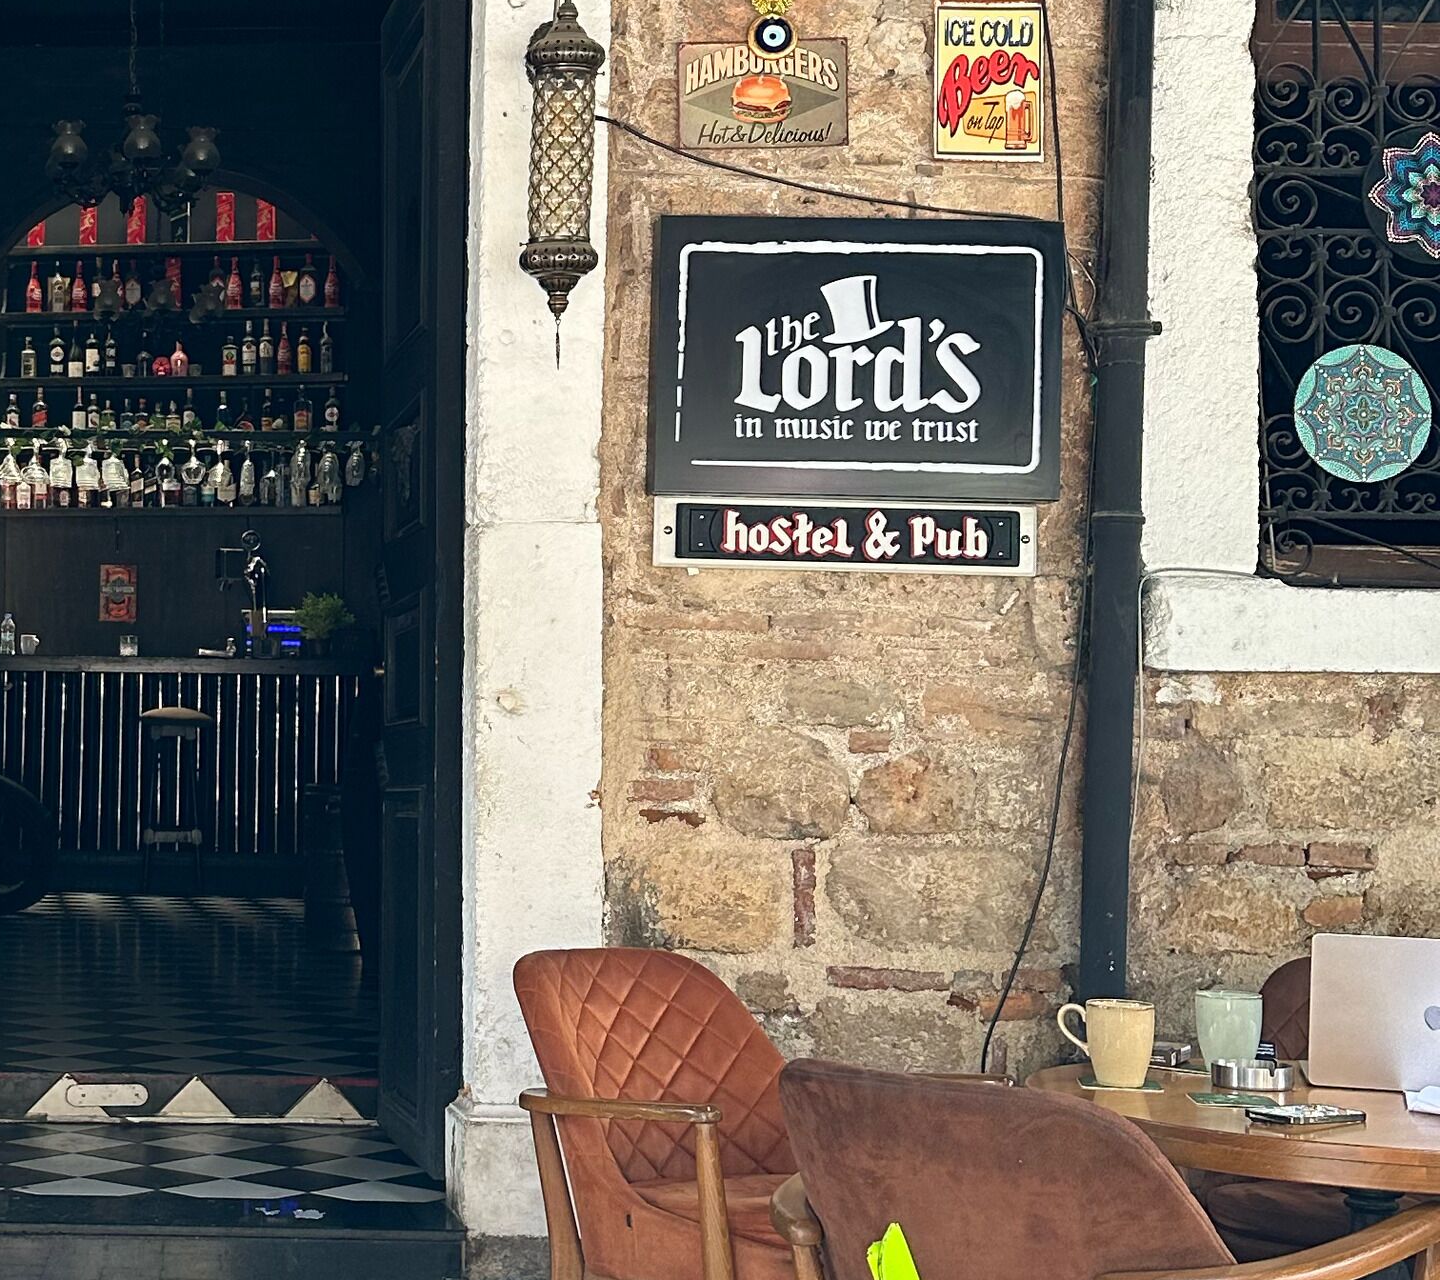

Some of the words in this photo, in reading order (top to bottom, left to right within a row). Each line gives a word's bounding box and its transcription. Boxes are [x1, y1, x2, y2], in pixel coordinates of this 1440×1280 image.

[944, 17, 975, 47] ICE
[979, 16, 1034, 48] COLD
[937, 49, 1040, 138] Beer
[966, 113, 984, 132] on
[980, 101, 1005, 145] Tap
[765, 311, 821, 356] the
[734, 413, 763, 439] in
[774, 414, 854, 441] music
[864, 418, 902, 441] we
[911, 416, 980, 443] trust
[722, 508, 855, 558] hostel
[864, 509, 901, 561] &
